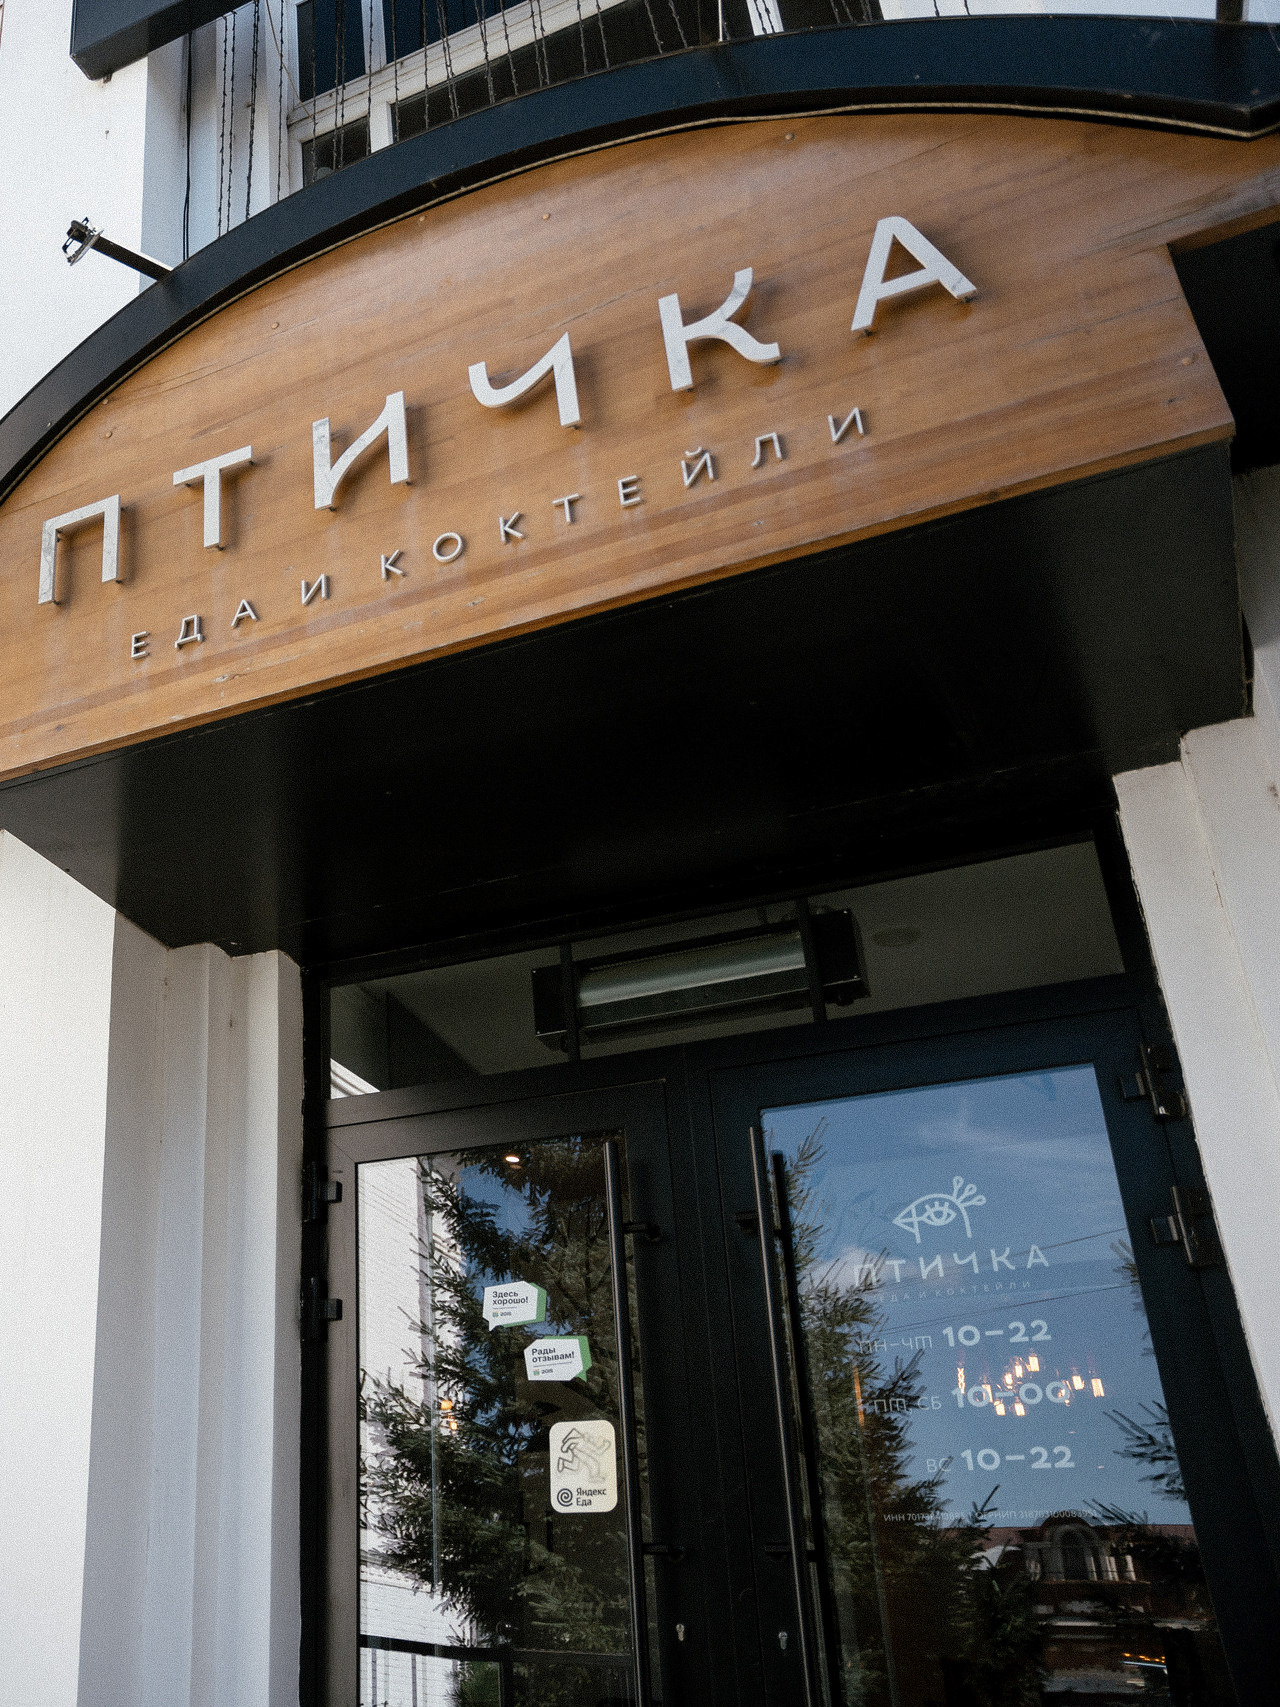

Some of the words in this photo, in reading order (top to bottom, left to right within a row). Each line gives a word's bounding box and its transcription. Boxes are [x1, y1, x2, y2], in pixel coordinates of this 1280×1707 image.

[38, 215, 978, 605] ПТИЧКА
[131, 599, 259, 660] ЕДА
[301, 573, 330, 606] И
[380, 406, 865, 582] КОКТЕЙЛИ
[853, 1244, 1050, 1287] ПТИЧКА
[492, 1290, 519, 1299] Здесь
[492, 1296, 529, 1306] хорошо!
[531, 1347, 556, 1356] Рады
[532, 1351, 575, 1363] отзывам!
[576, 1487, 608, 1497] Яндекс
[576, 1498, 593, 1507] Еда
